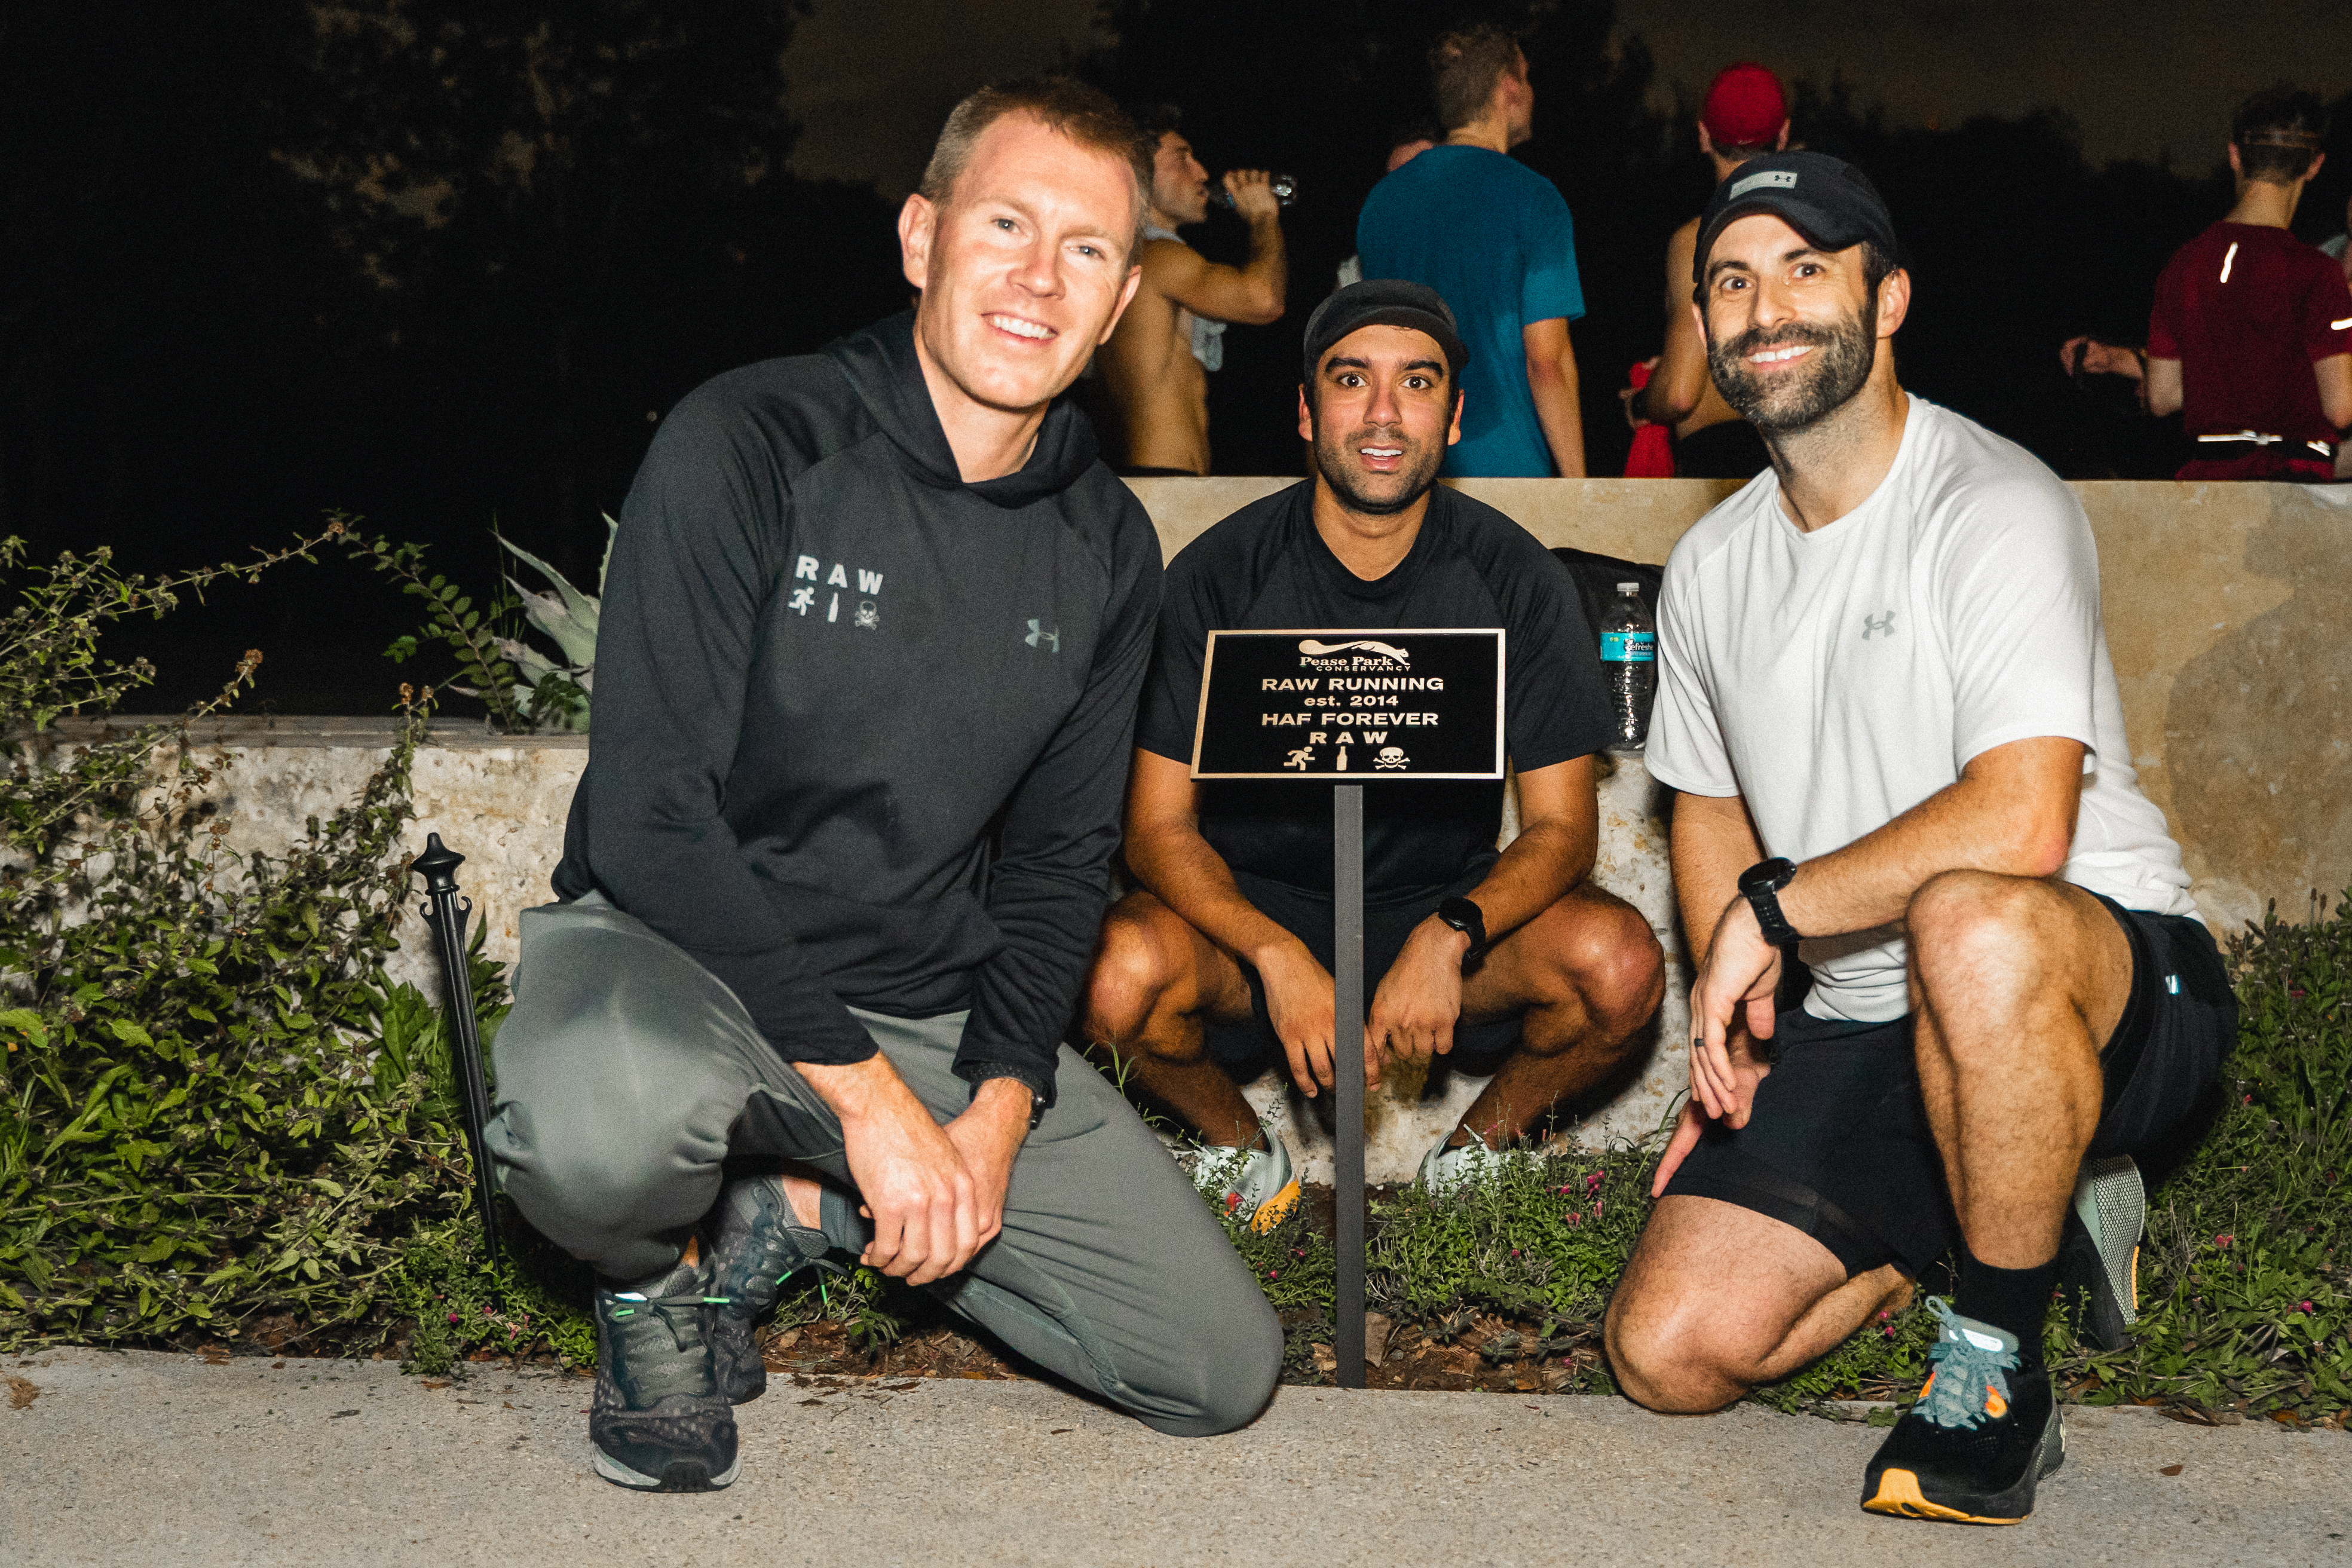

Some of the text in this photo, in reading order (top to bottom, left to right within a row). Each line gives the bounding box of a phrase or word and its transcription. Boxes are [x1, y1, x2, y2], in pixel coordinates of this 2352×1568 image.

[1299, 656, 1393, 666] Pease Park
[1262, 678, 1444, 691] RAW RUNNING
[1304, 696, 1399, 706] est. 2014
[1261, 713, 1439, 725] HAF FOREVER
